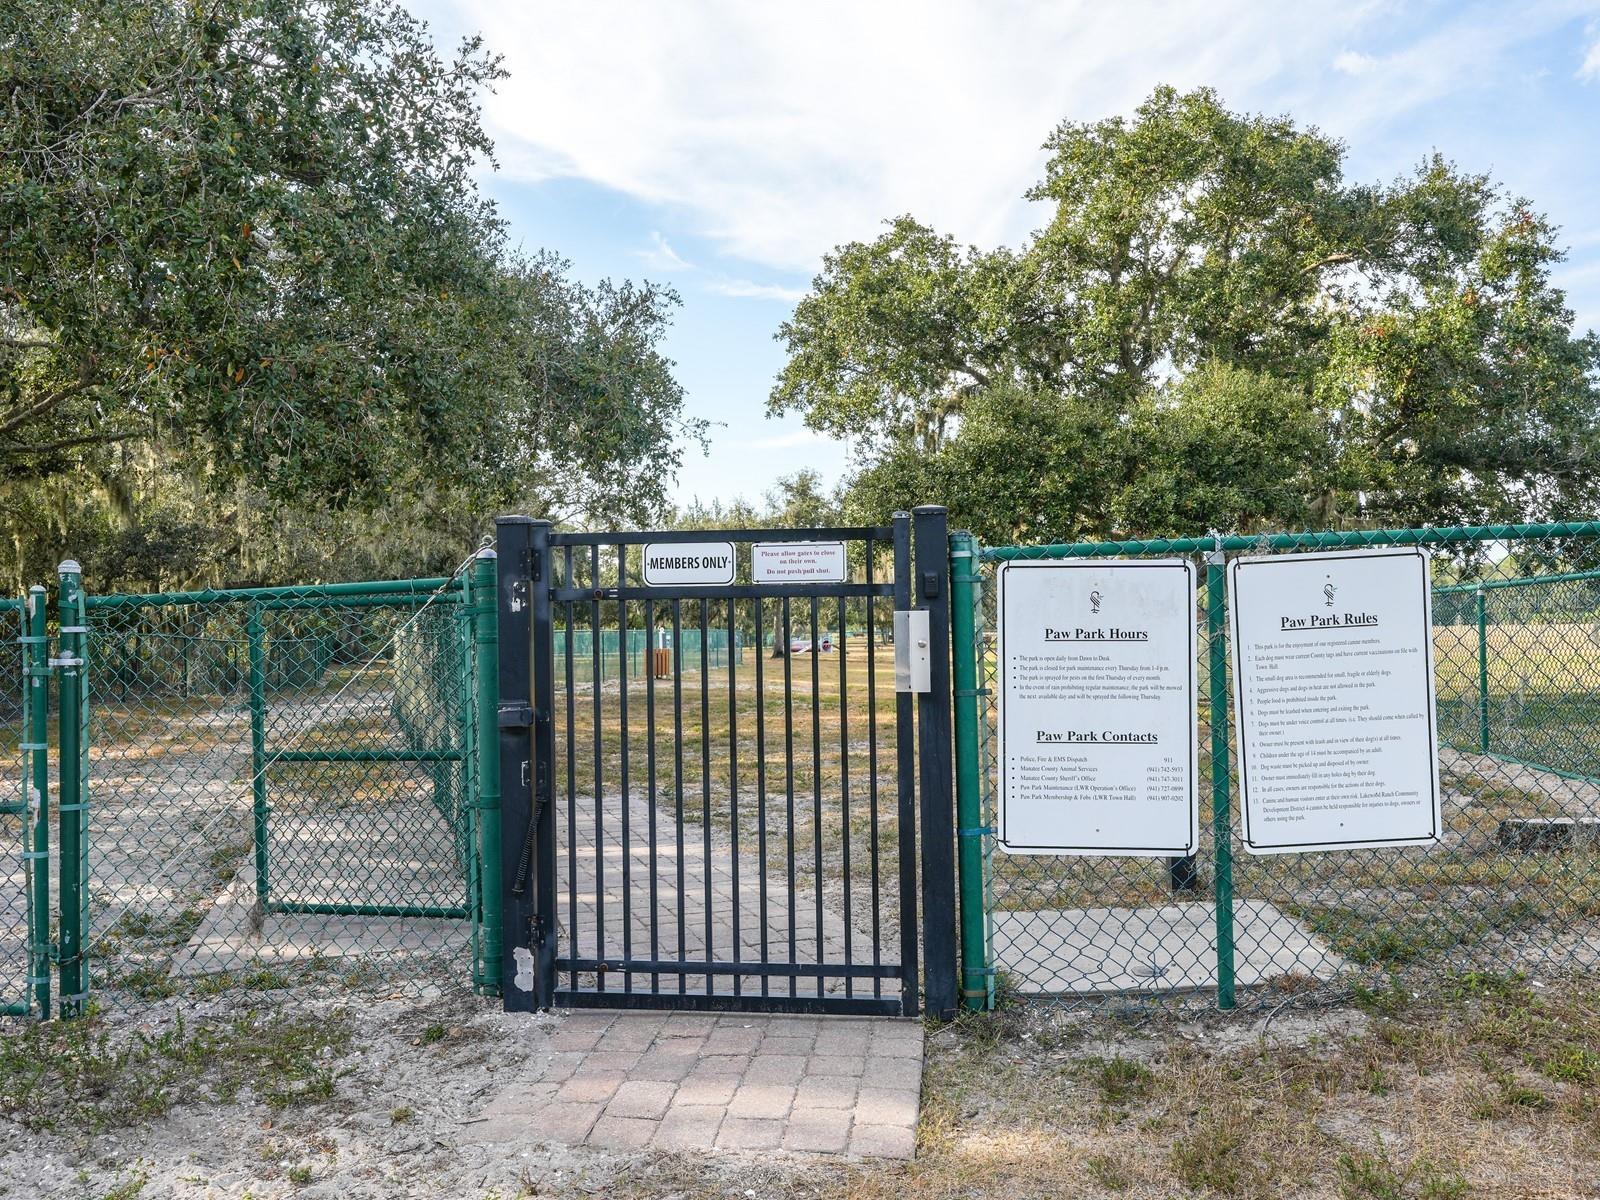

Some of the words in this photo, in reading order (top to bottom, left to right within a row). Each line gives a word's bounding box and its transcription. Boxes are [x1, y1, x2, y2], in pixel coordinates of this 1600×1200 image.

[650, 557, 699, 569] MEMBERS
[703, 556, 728, 569] ONLY
[1281, 616, 1307, 628] Paw
[1311, 614, 1340, 627] Park
[1345, 613, 1378, 624] Rules
[1045, 628, 1071, 639] Paw
[1076, 628, 1105, 639] Park
[1110, 628, 1148, 639] Hours
[1037, 731, 1063, 741] Paw
[1068, 731, 1097, 741] Park
[1102, 731, 1158, 742] Contacts
